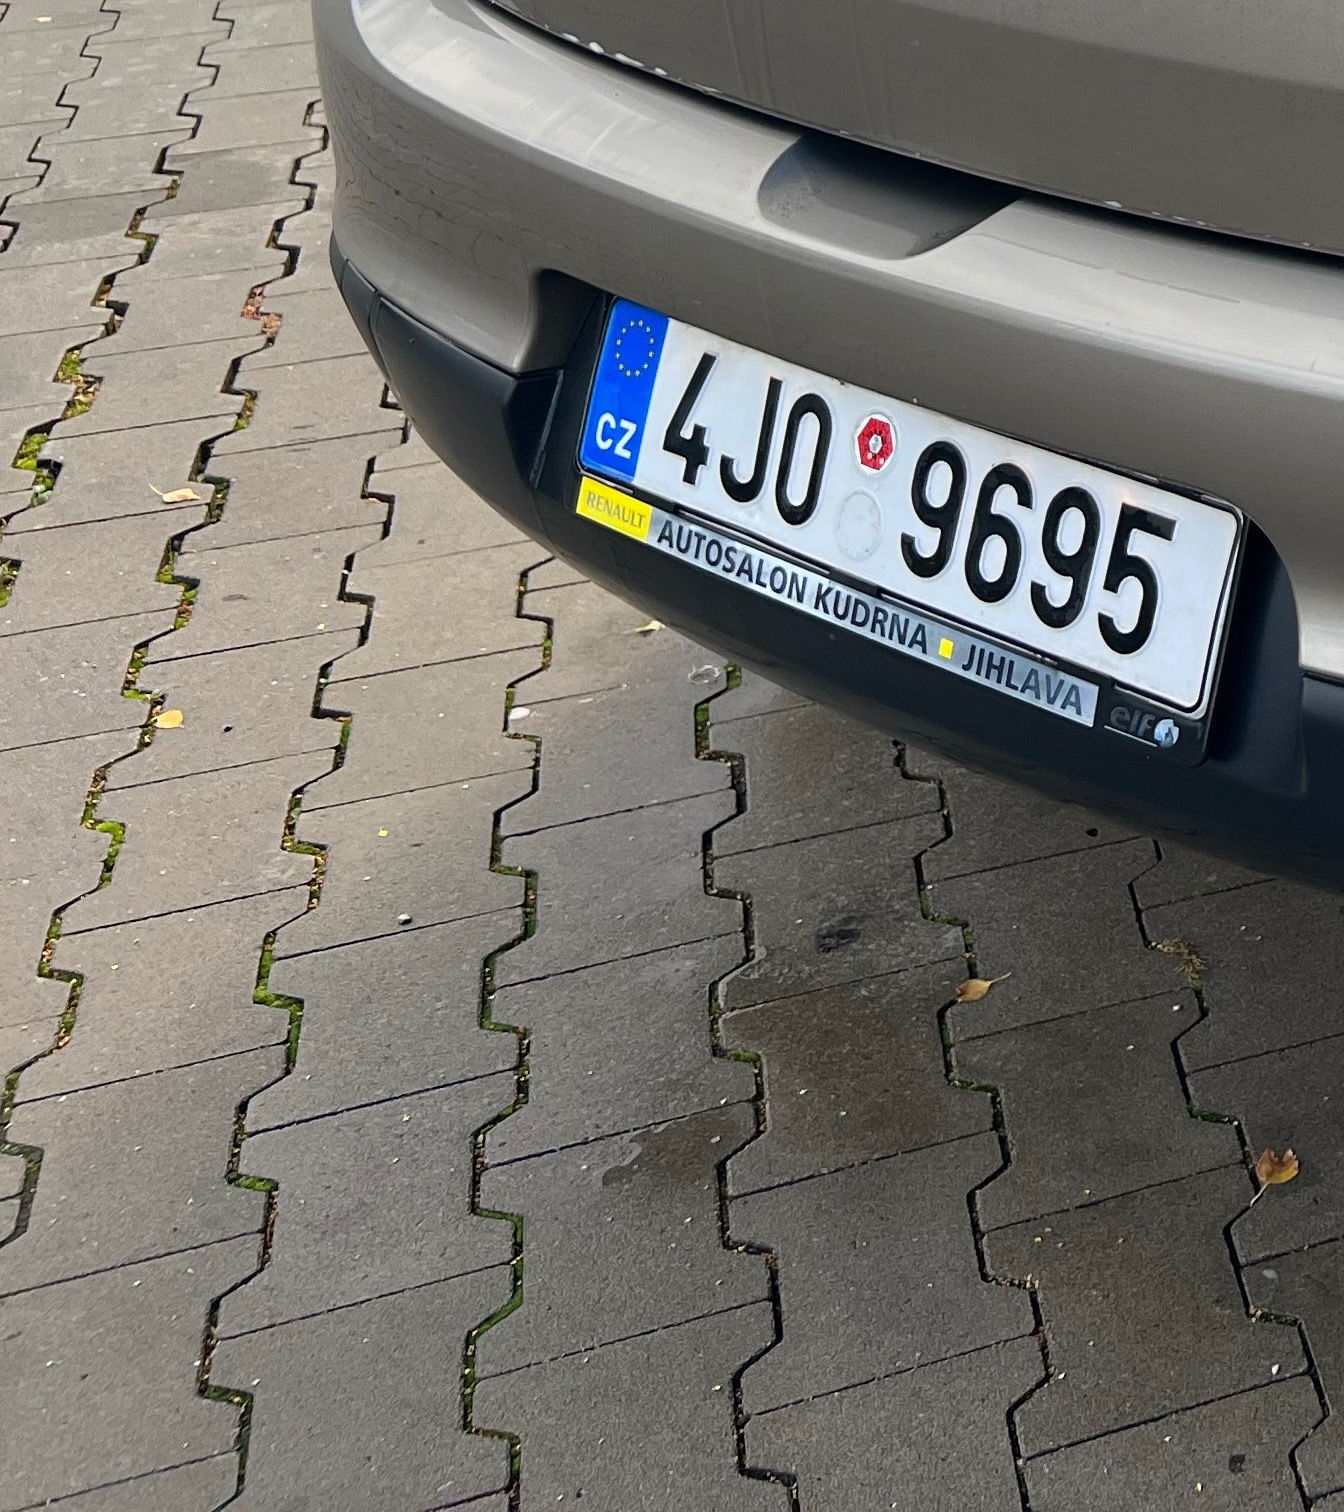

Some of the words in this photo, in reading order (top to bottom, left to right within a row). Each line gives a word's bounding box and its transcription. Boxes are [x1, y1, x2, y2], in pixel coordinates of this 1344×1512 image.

[595, 412, 637, 459] CZ
[586, 491, 647, 529] RENAULT
[662, 352, 832, 525] 4J0
[900, 440, 1177, 654] 9695
[656, 519, 808, 603] AUTOSALON
[814, 583, 928, 654] KUDRNA
[961, 644, 1083, 716] JIHLAVA
[1109, 706, 1156, 734] elf
